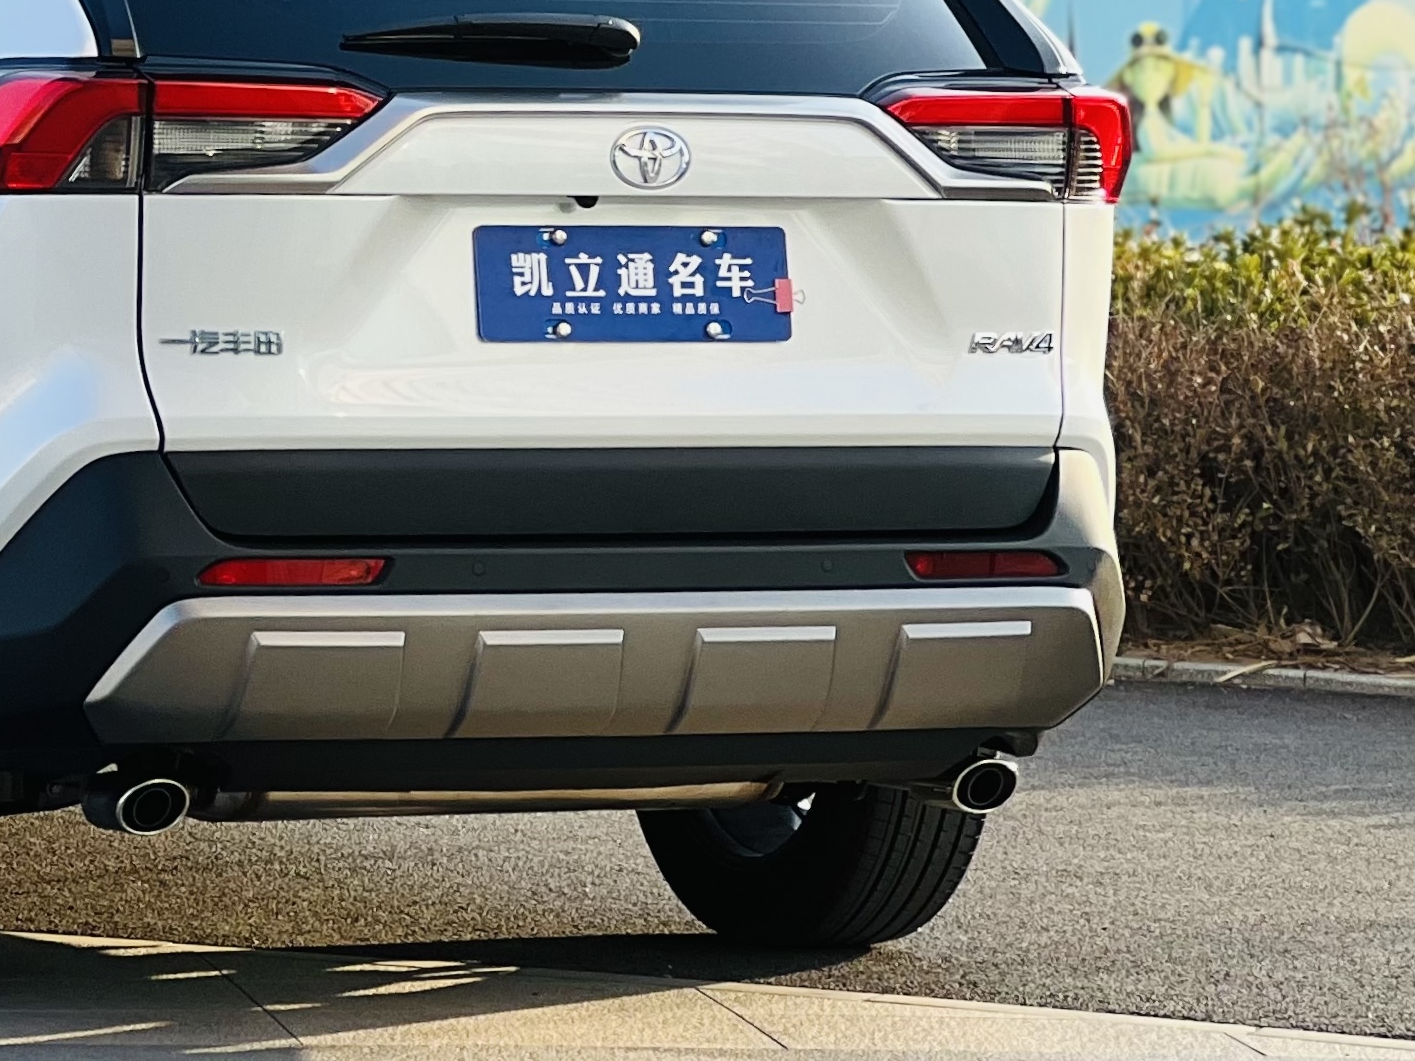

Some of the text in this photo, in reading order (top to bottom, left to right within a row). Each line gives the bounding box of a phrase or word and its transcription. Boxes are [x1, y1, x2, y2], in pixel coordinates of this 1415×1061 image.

[510, 252, 755, 298] 凯立通名车
[159, 330, 284, 355] 一汽丰田
[967, 331, 1055, 355] RAV4
